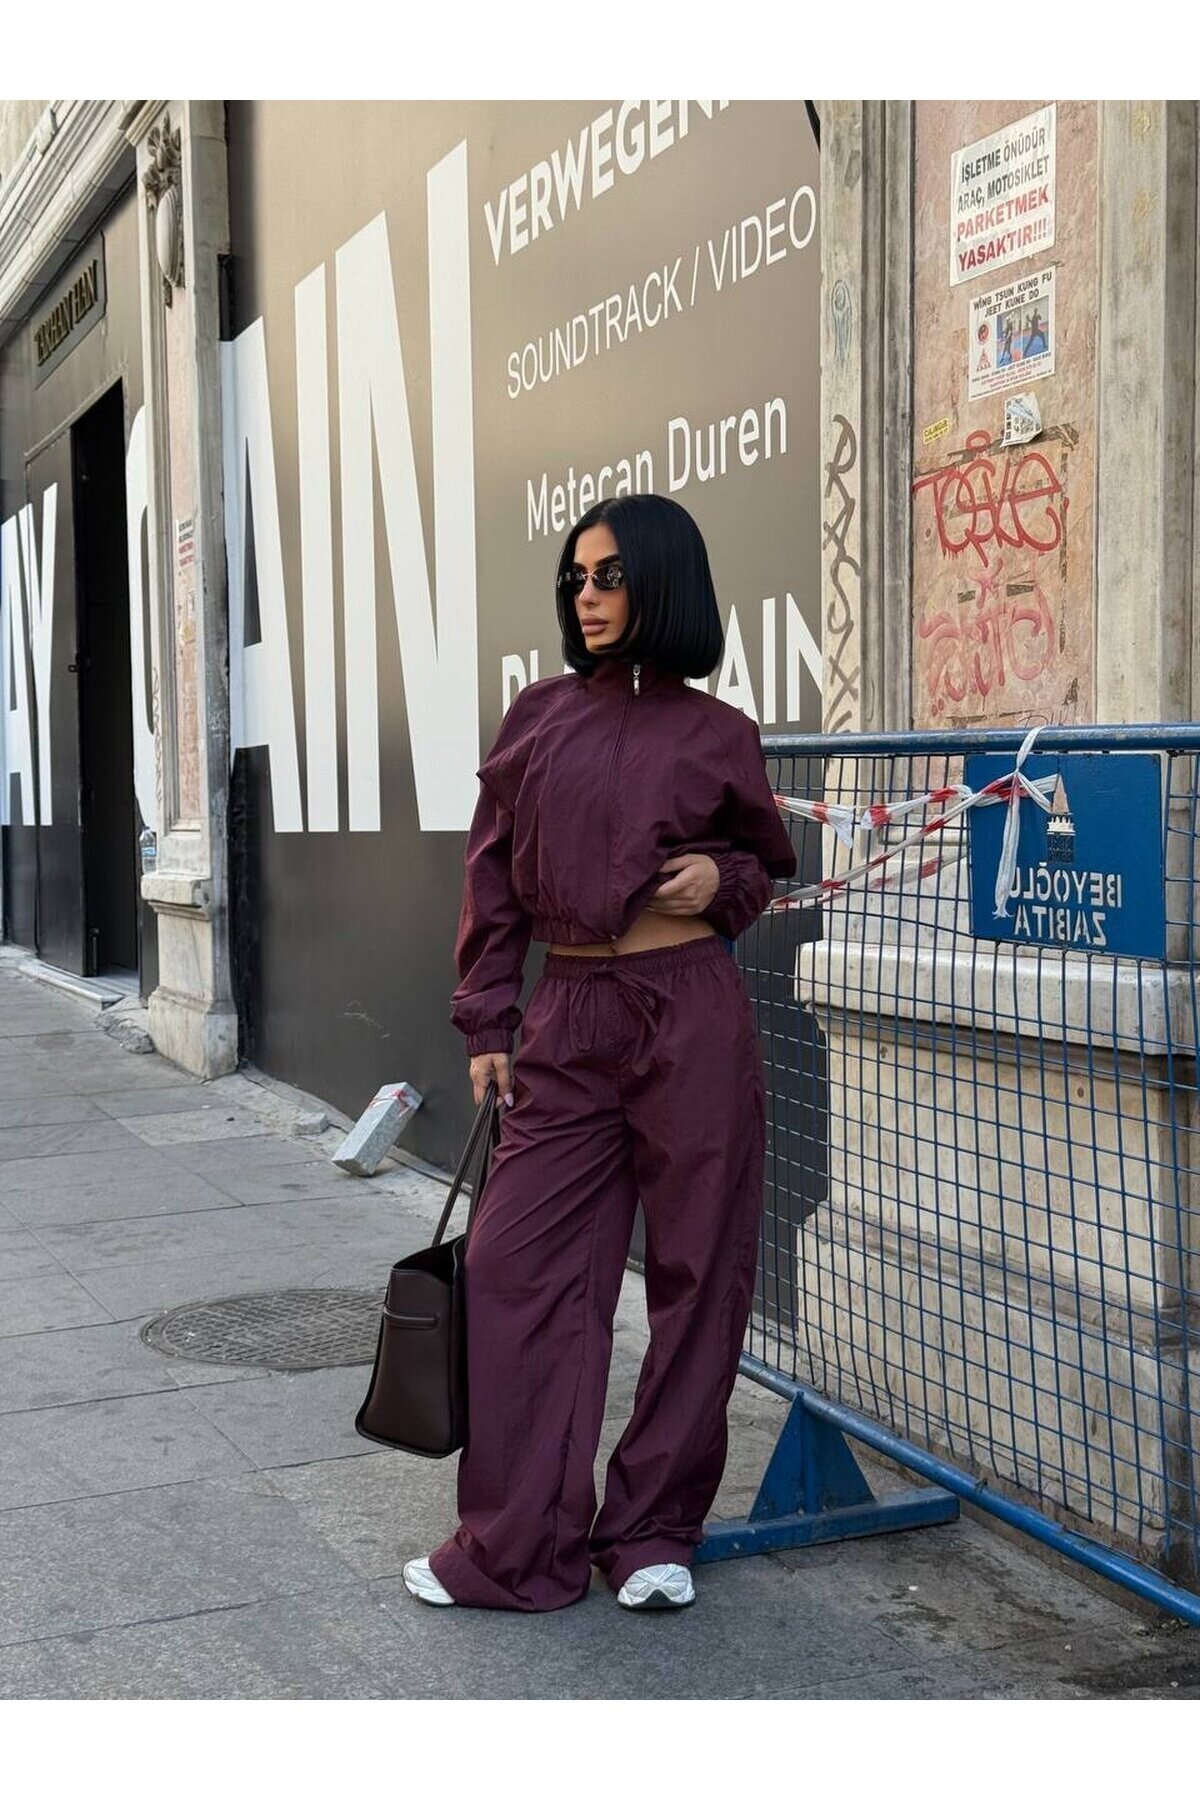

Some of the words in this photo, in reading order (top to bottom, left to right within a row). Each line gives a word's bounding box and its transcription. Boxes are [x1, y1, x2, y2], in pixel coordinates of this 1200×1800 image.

[483, 100, 729, 267] VERWEGE
[957, 187, 986, 214] ARAÇ,
[987, 155, 1050, 199] MOTOSİKLET
[961, 148, 1001, 186] İŞLETME
[1003, 126, 1046, 163] ÖNÜDÜR
[956, 184, 1049, 242] PARKETMEK
[958, 218, 1047, 271] YASAKTIR!!!
[508, 257, 683, 399] SOUNDTRACK
[690, 246, 700, 306] /
[708, 185, 817, 292] VIDEO
[985, 303, 1002, 319] JEET
[995, 286, 1015, 302] TSUN
[1018, 277, 1038, 293] KUNG
[1042, 271, 1052, 283] FU
[527, 450, 654, 542] Metecan
[667, 397, 788, 493] Duren
[682, 592, 823, 725] AIN
